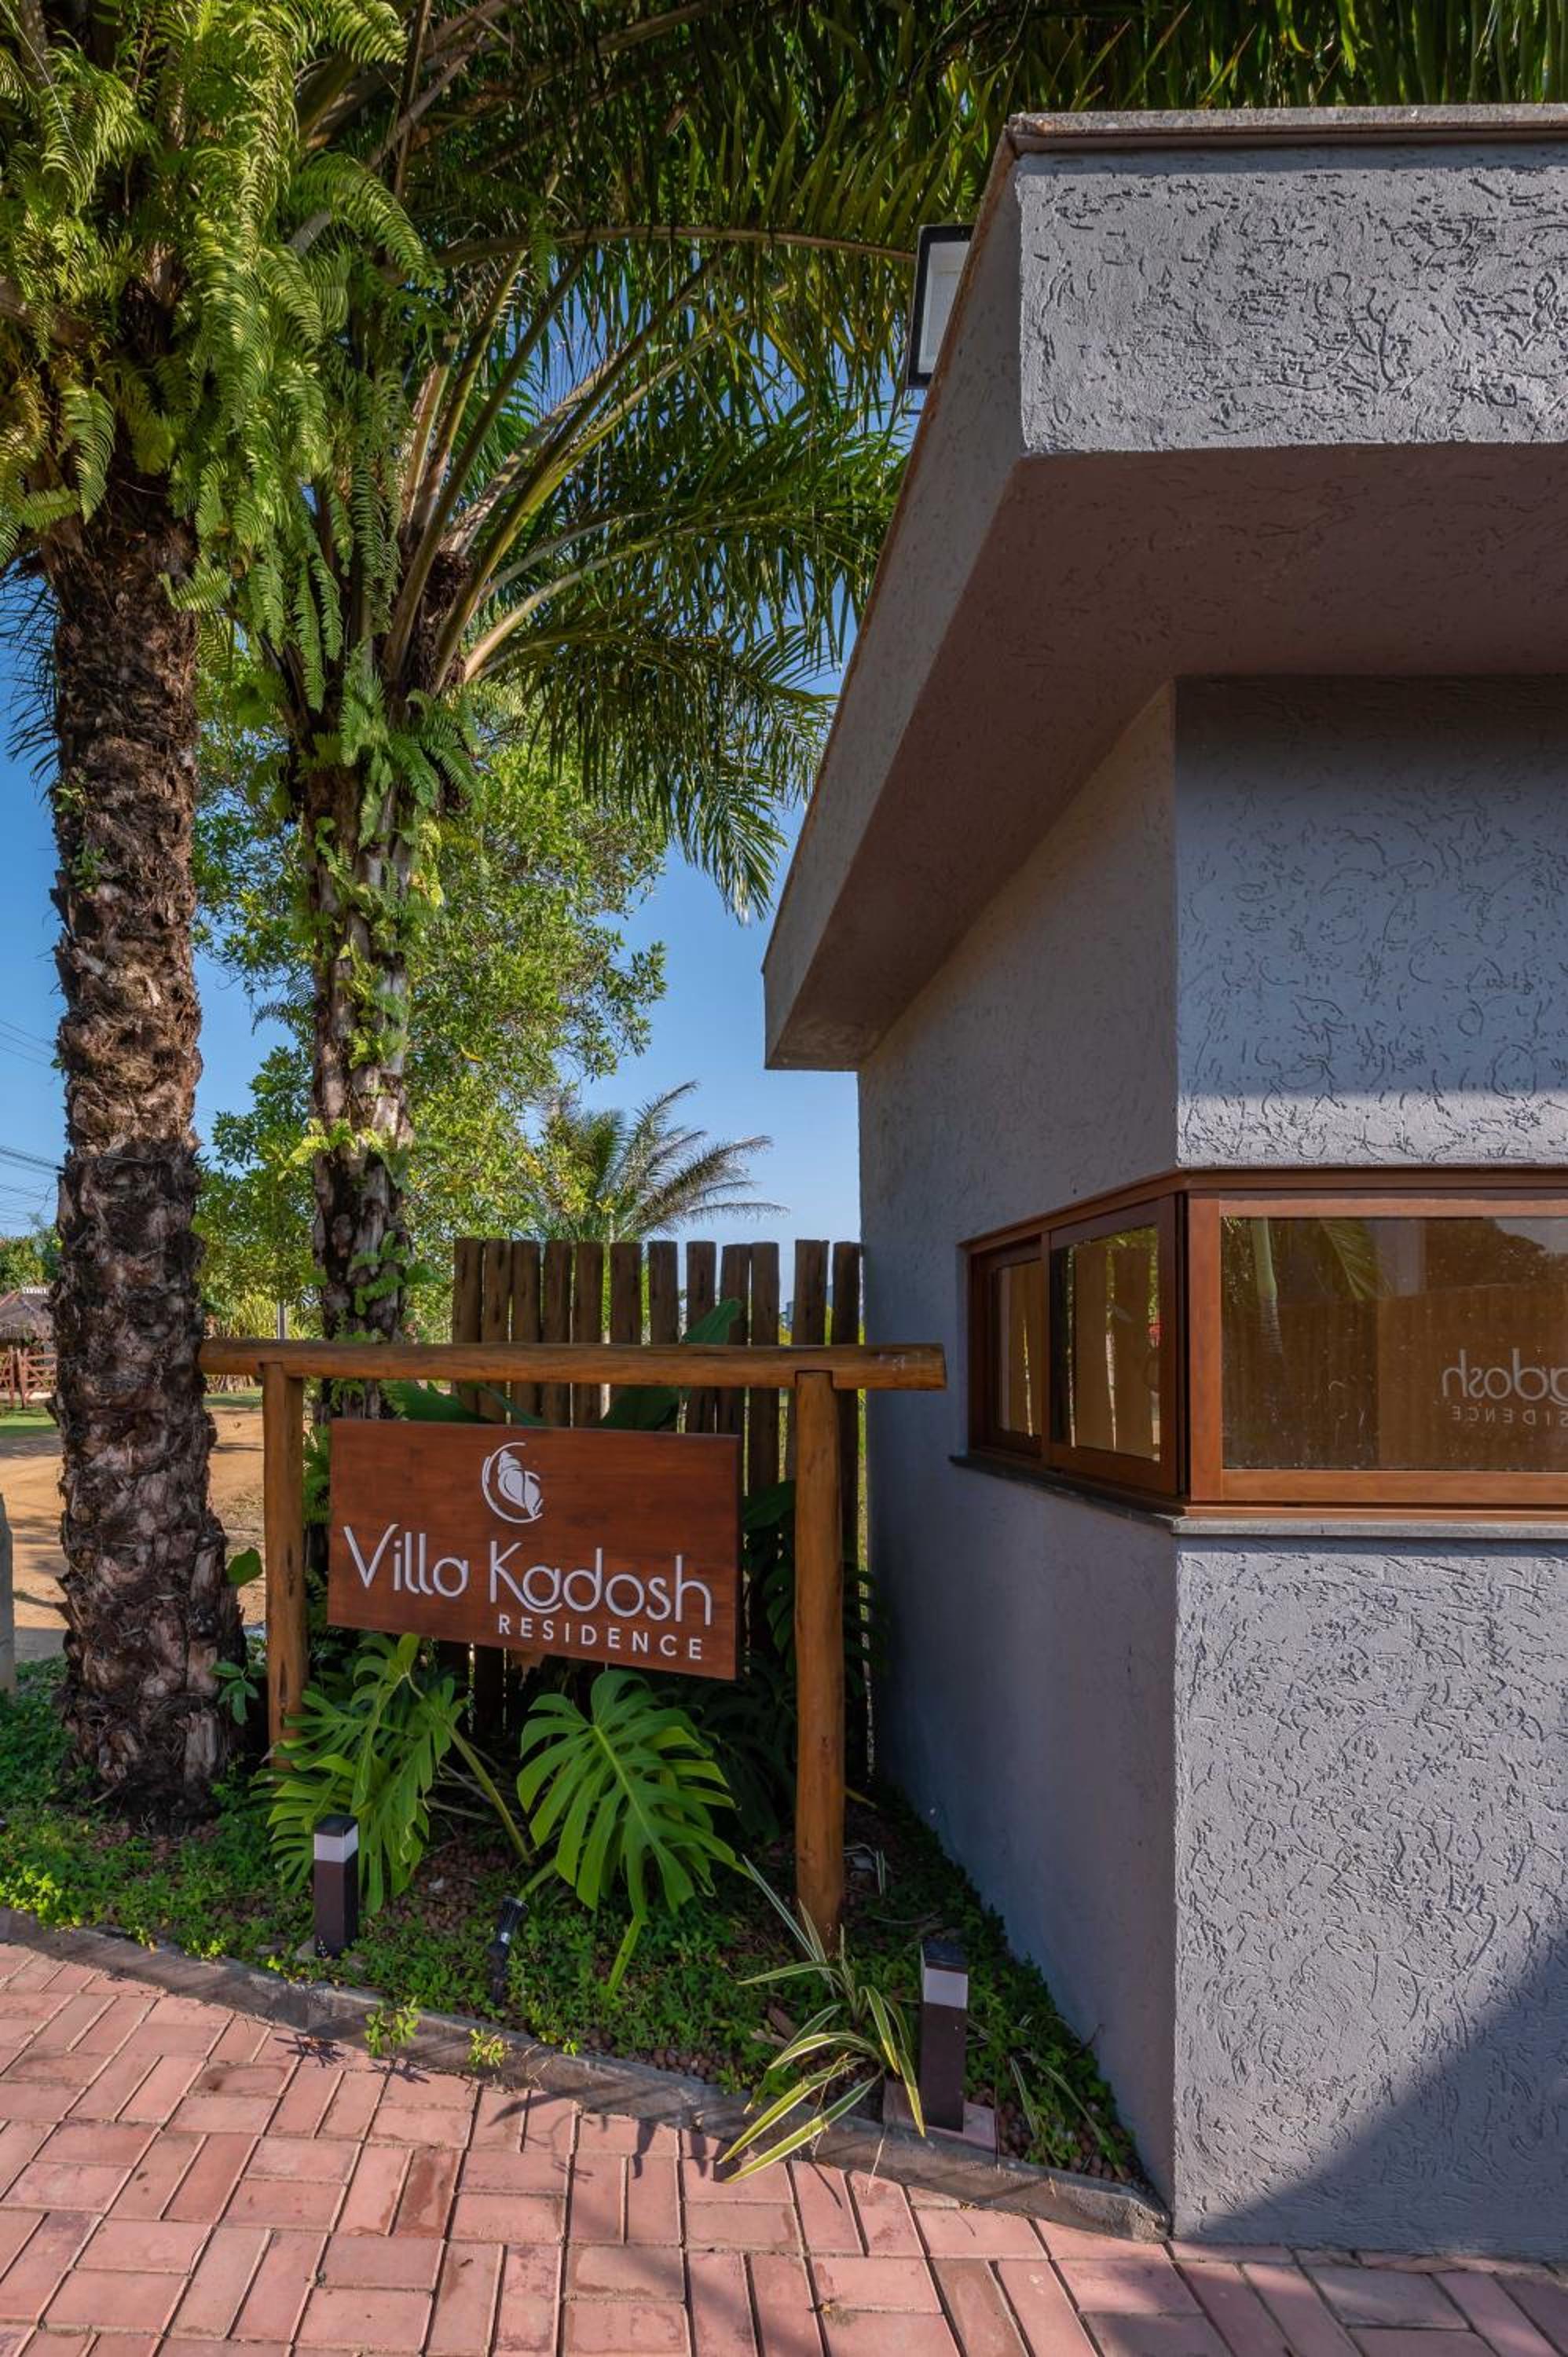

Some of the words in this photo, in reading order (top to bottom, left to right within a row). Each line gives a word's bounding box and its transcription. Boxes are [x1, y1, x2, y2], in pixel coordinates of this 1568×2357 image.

[343, 1524, 469, 1597] Villa
[489, 1541, 713, 1626] Kadosh
[499, 1615, 702, 1660] RESIDENCE
